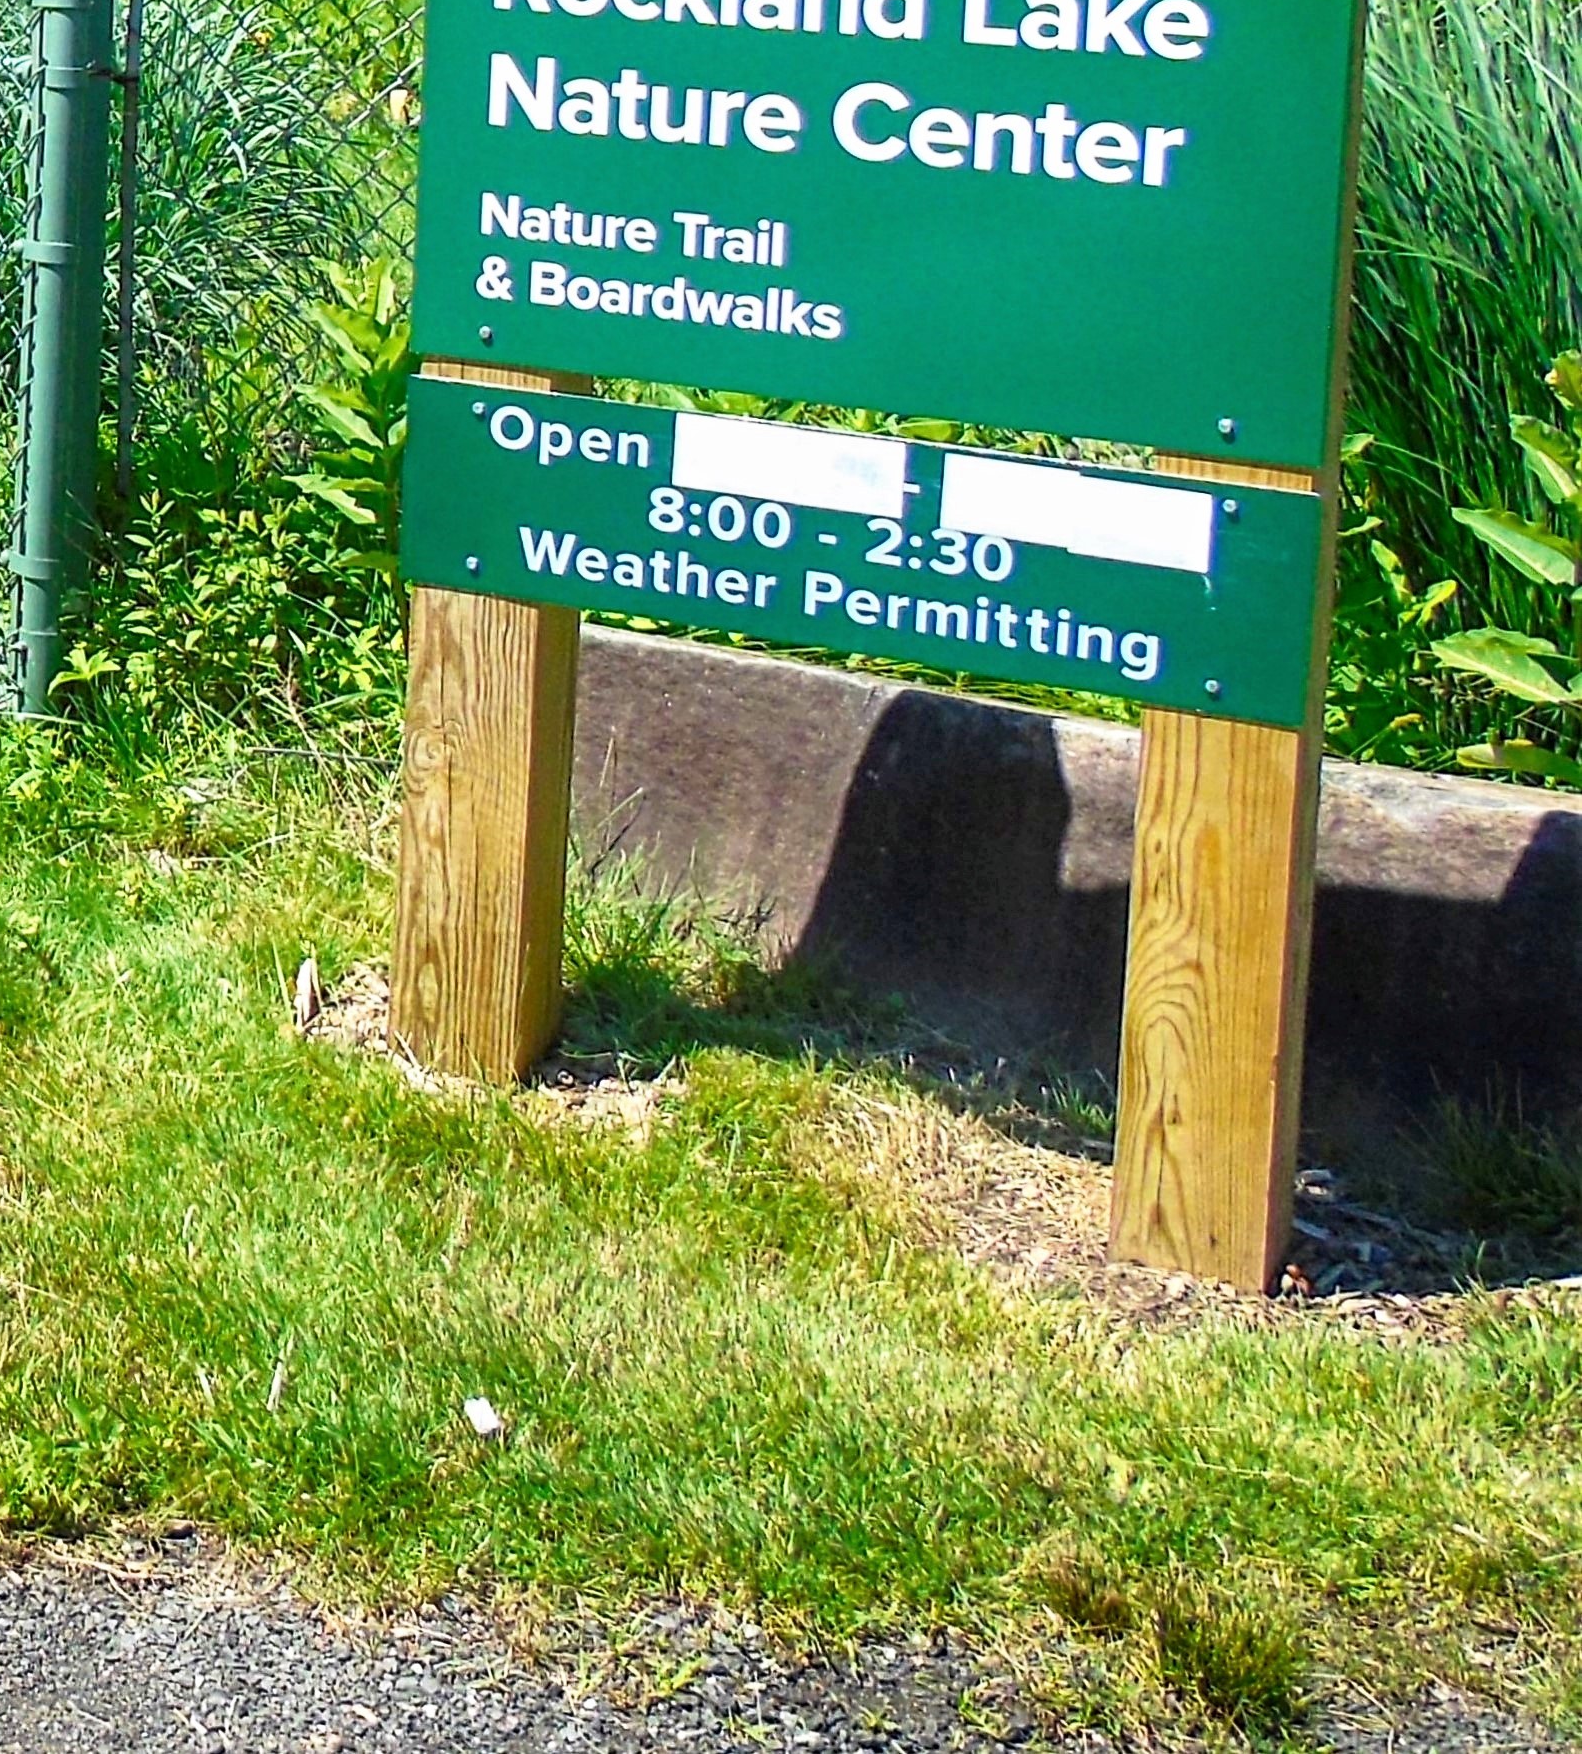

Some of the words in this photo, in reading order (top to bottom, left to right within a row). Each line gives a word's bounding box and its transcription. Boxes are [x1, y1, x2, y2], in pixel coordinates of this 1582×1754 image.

[487, 53, 802, 153] Nature
[832, 82, 1186, 187] Center
[479, 192, 658, 256] Nature
[673, 212, 786, 267] Trail
[475, 255, 513, 301] &
[529, 261, 843, 339] Boardwalks
[490, 405, 650, 468] Open
[647, 487, 791, 548] 8:00
[864, 517, 1016, 584] 2:30
[518, 526, 778, 609] Weather
[803, 571, 1160, 682] Permitting
